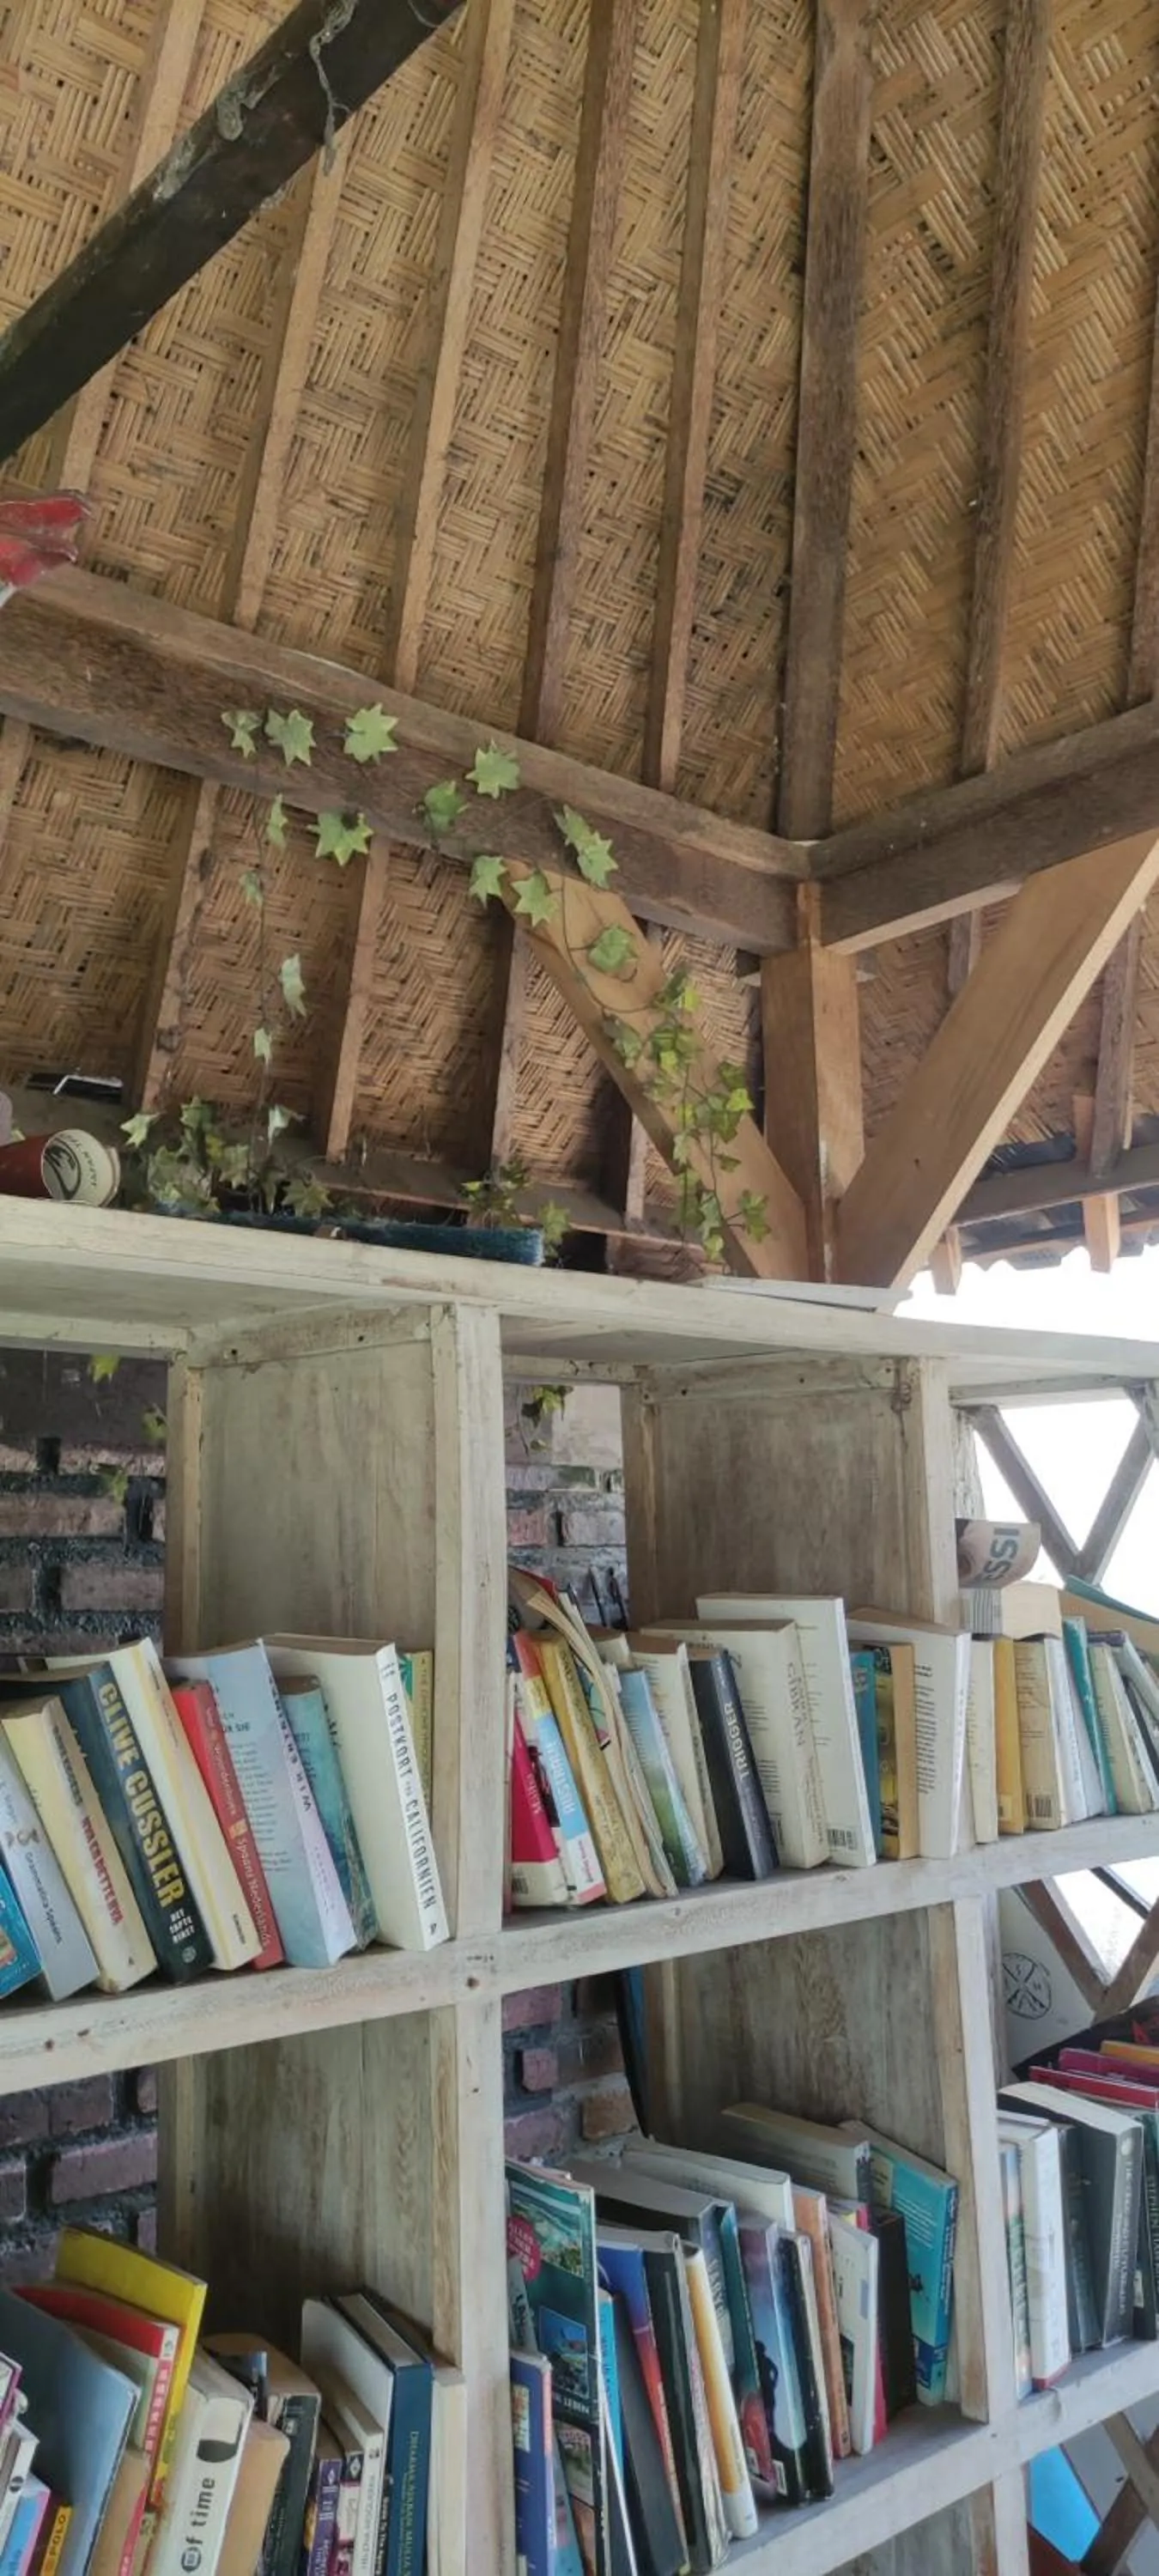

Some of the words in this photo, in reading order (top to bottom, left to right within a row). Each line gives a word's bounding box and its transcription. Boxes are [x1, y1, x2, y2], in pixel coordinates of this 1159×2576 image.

[723, 1702, 751, 1779] TRIGGER
[100, 1683, 139, 1768] CLIVE
[124, 1771, 185, 1908] CUSSLER
[385, 1692, 412, 1778] POSTKORT
[406, 1799, 435, 1910] CALIFORNIEN
[50, 2514, 66, 2556] POLO
[190, 2476, 216, 2528] time
